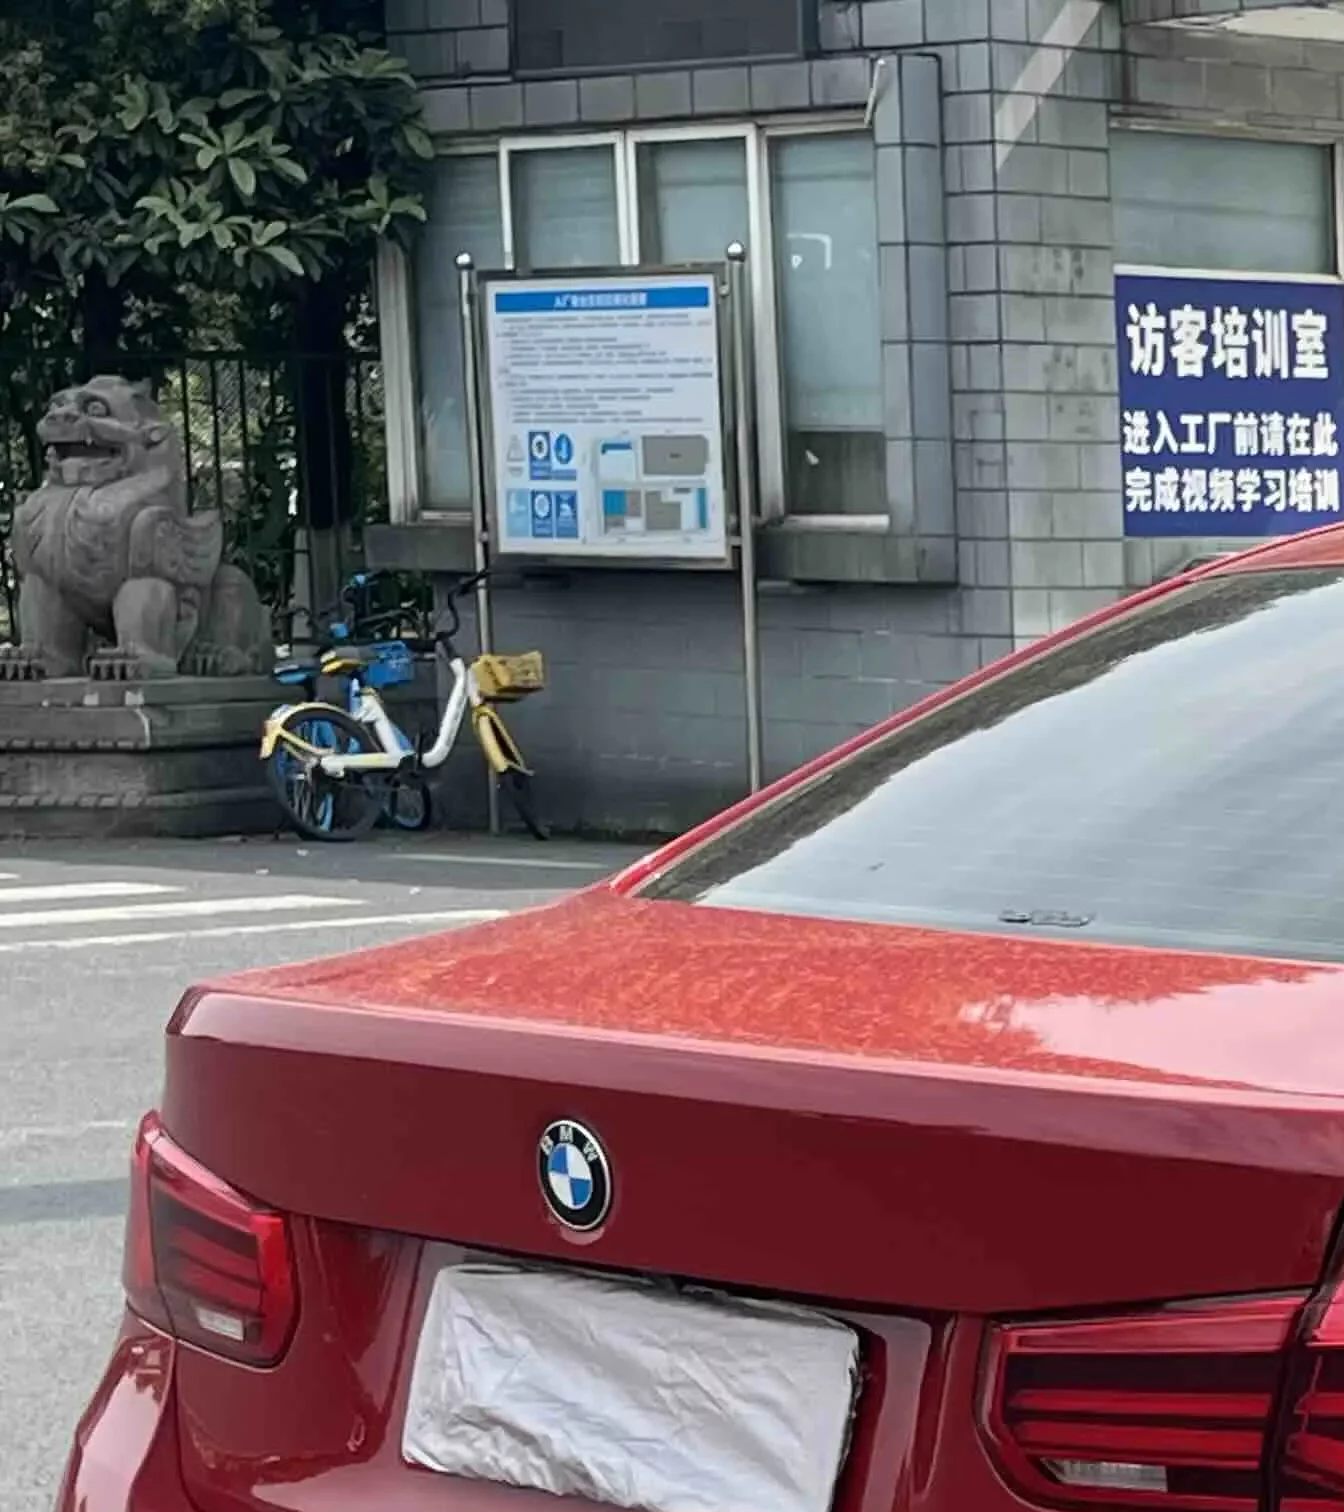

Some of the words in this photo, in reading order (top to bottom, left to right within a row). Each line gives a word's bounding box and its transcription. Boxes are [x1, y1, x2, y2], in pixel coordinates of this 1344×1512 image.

[1126, 303, 1329, 379] 访客培训室
[1123, 410, 1339, 456] 进入工厂前请在此
[1125, 466, 1341, 512] 完成视频学习培训
[540, 1125, 598, 1162] BMW
